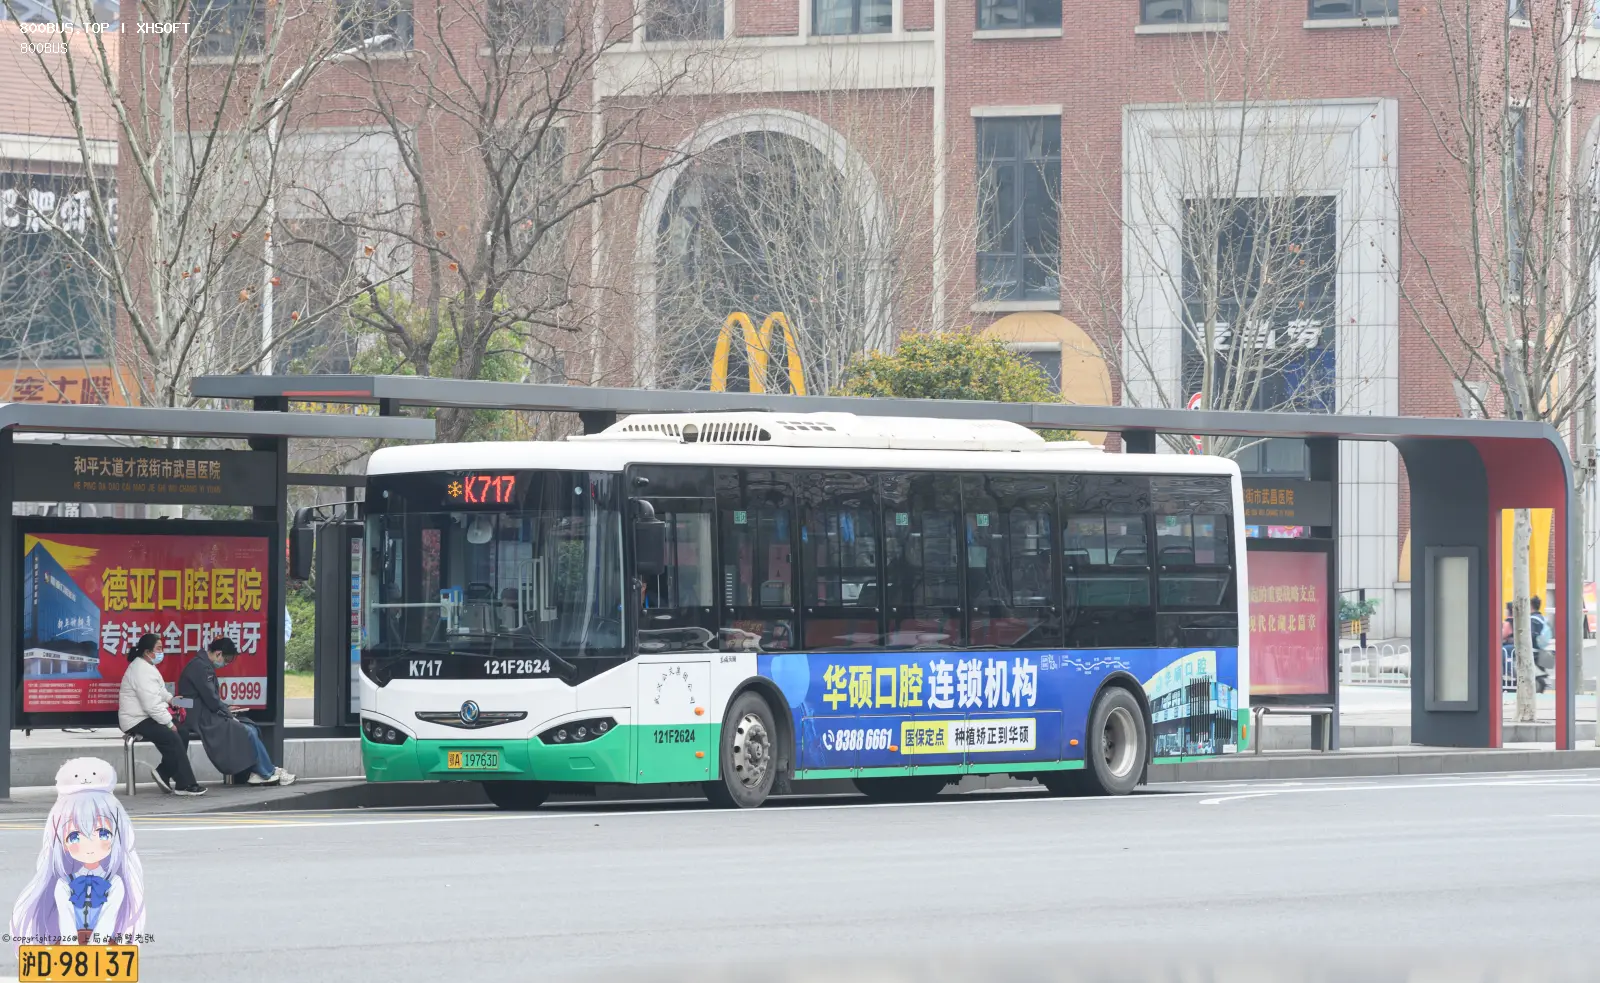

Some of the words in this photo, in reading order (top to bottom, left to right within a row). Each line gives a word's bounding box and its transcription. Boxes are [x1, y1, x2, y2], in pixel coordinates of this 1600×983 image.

[74, 455, 221, 480] 和平大道才茂街市武昌医院
[464, 475, 516, 503] K717
[1243, 488, 1294, 506] 街市武昌医院
[101, 566, 263, 612] 德亚口腔医院
[409, 659, 443, 677] K717
[483, 659, 551, 675] 121F2624
[230, 681, 261, 701] 9999
[823, 663, 924, 711] 华硕口腔
[927, 657, 1038, 710] 连锁机构
[653, 728, 696, 744] 121F2624
[835, 729, 864, 751] 8388
[865, 728, 894, 750] 6661
[904, 728, 945, 748] 医保定点
[954, 725, 1030, 745] 种植矫正到华硕
